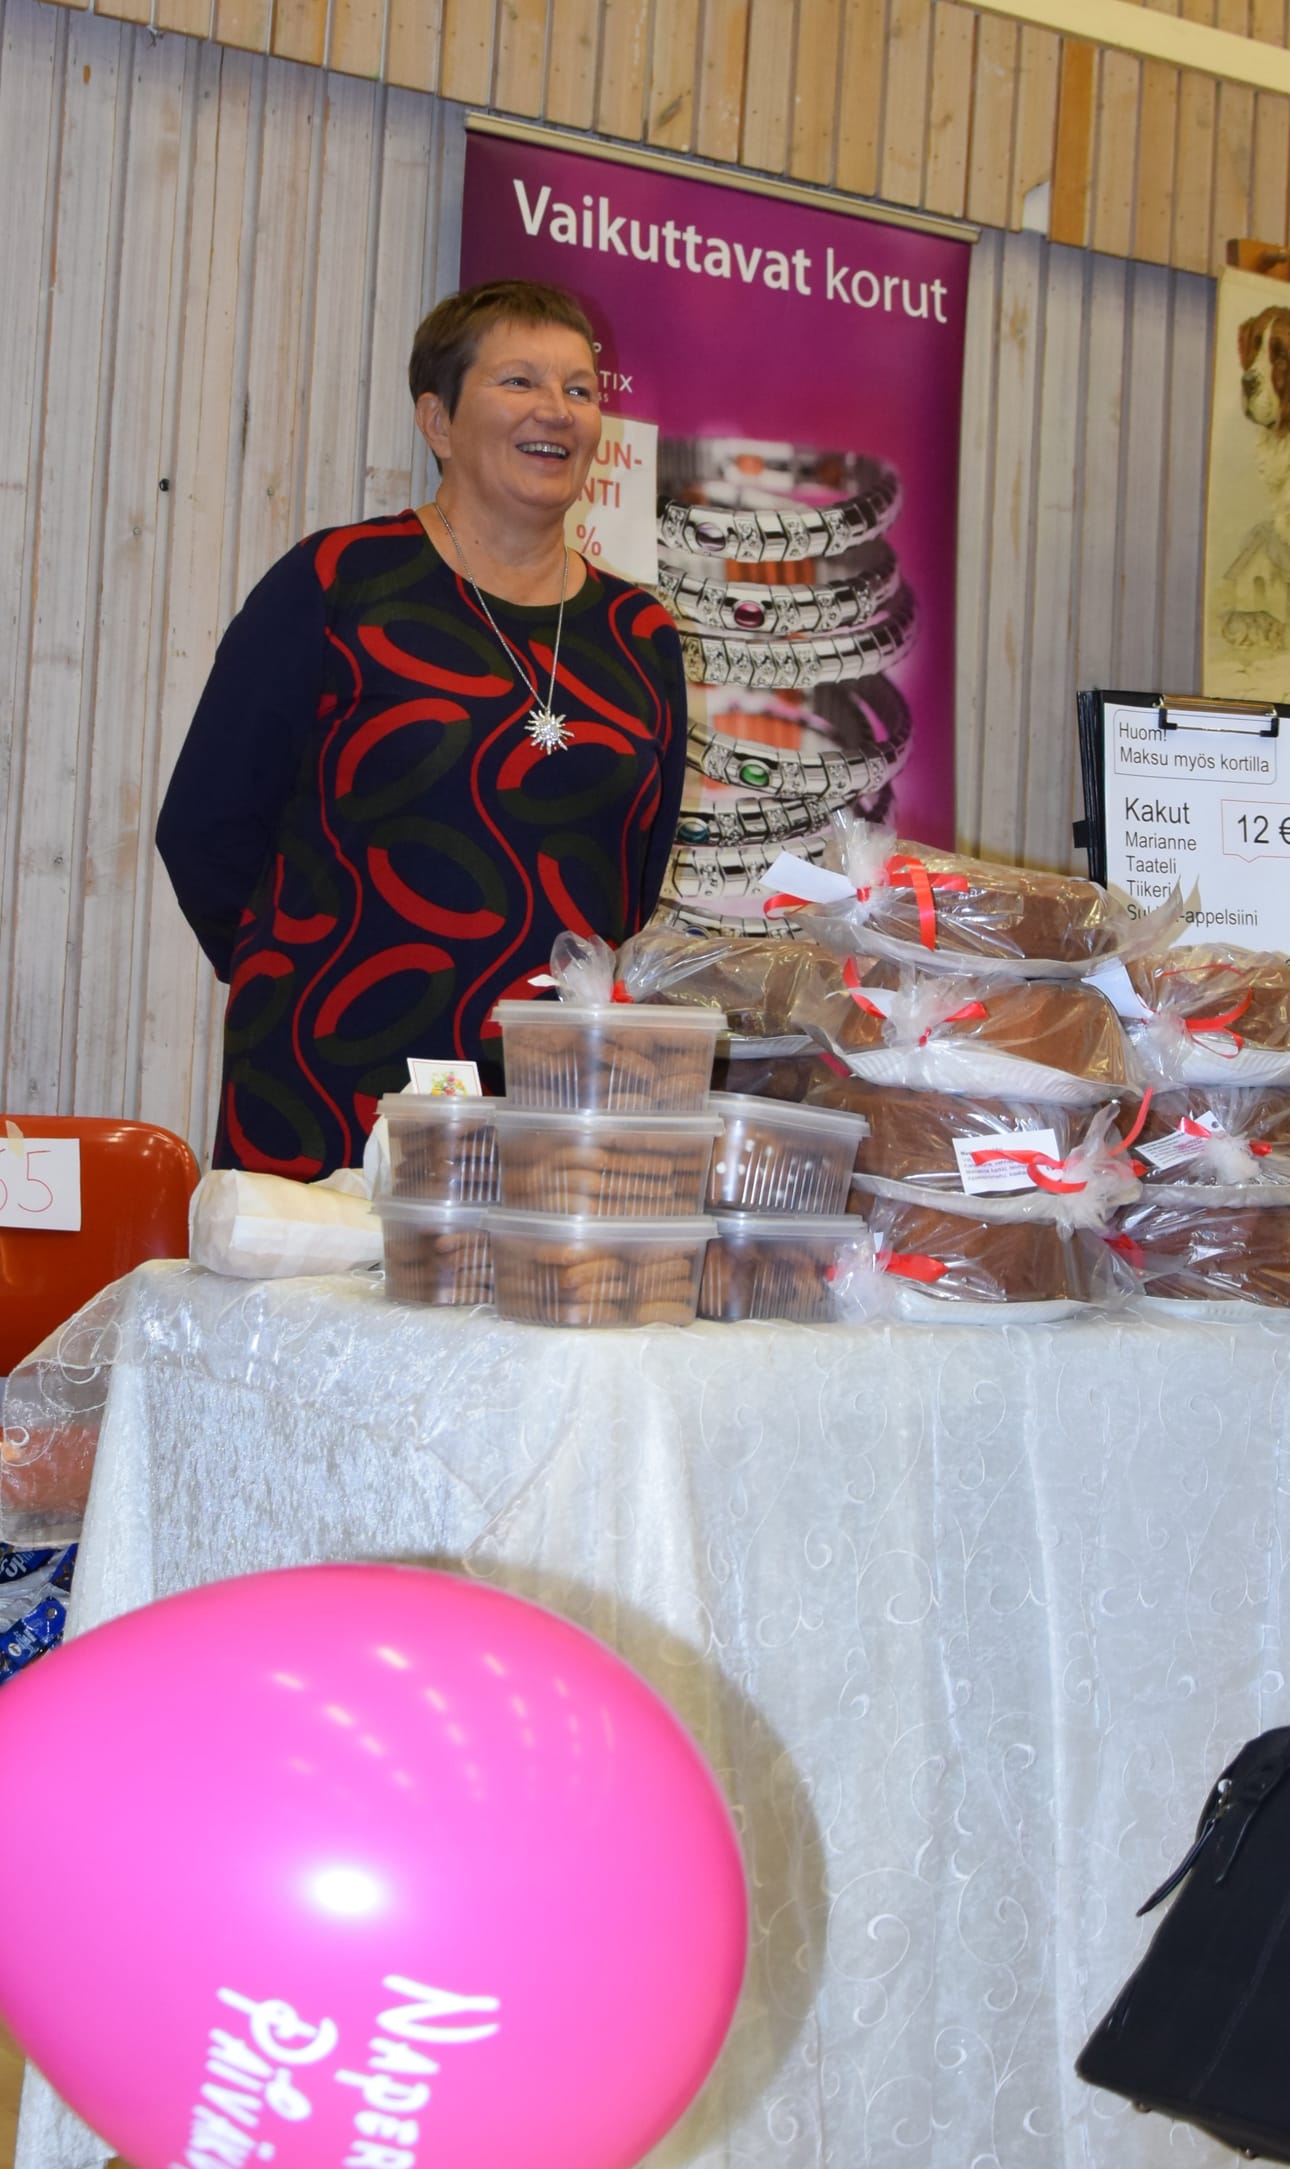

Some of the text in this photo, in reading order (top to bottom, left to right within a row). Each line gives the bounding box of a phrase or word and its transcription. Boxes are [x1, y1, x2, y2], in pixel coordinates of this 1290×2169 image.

[513, 179, 948, 323] Vaikuttavat korut
[599, 370, 633, 394] TIX
[594, 439, 643, 470] UN-
[577, 478, 620, 508] NTI
[1119, 722, 1167, 742] Huom!
[1120, 746, 1270, 773] Maksu myös kortilla
[1125, 797, 1190, 824] Kakut
[1125, 831, 1198, 851] Marianne
[1237, 814, 1270, 844] 12
[1125, 855, 1177, 874] Taateli
[1126, 879, 1172, 898] Tiikeri
[0, 1148, 54, 1213] 5
